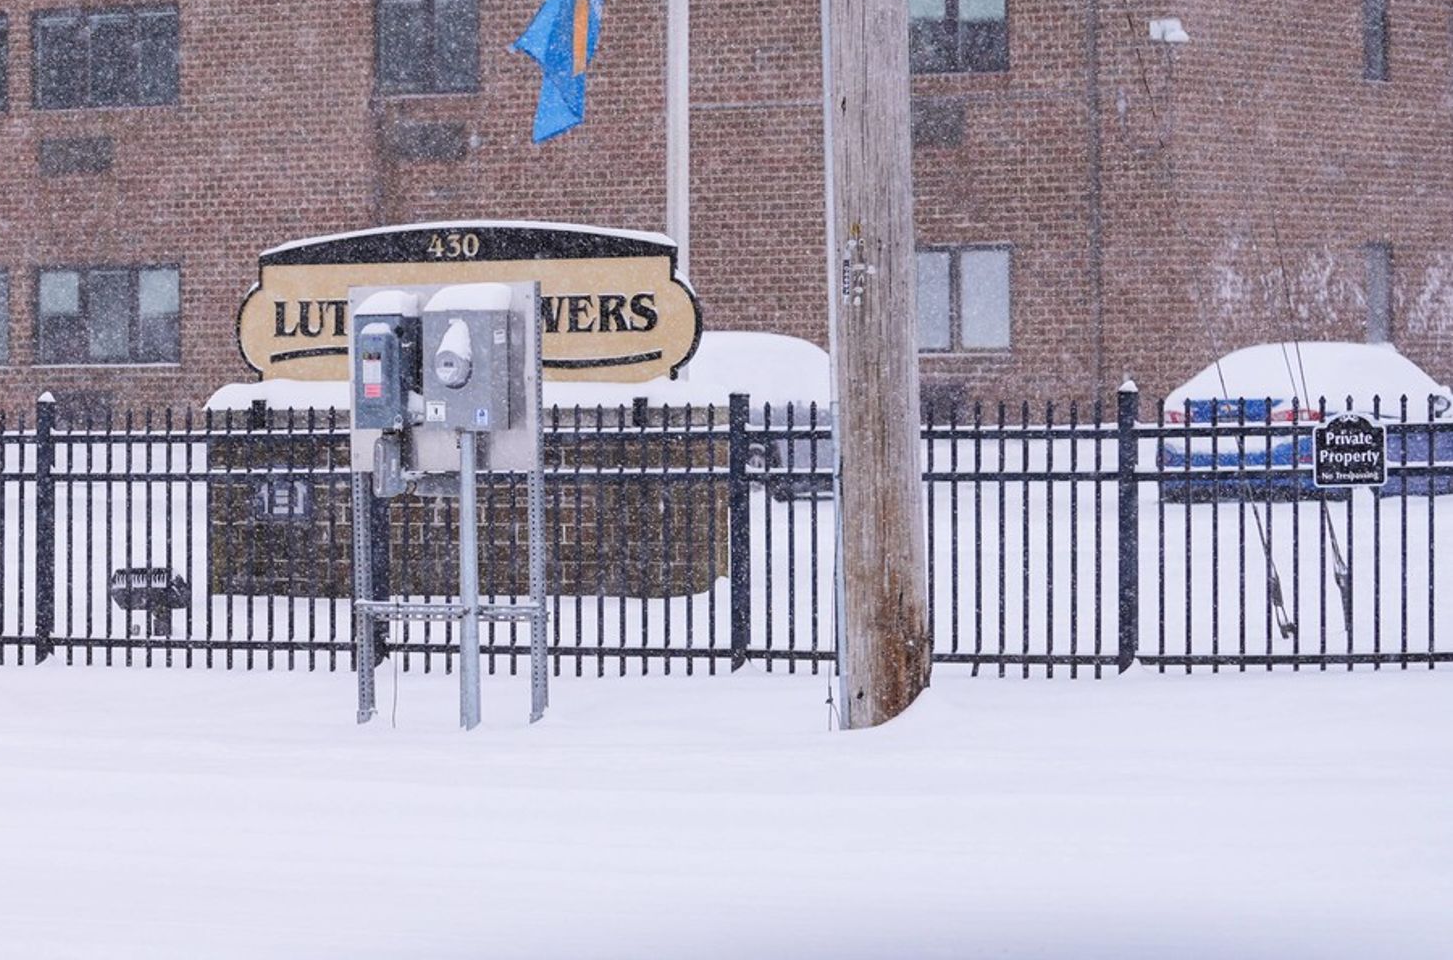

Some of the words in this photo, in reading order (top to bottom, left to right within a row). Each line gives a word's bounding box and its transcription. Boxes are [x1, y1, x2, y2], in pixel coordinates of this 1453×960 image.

[426, 233, 481, 257] 430
[274, 300, 348, 337] LUT
[541, 293, 658, 333] WERS
[1325, 430, 1373, 445] Private
[1320, 450, 1380, 466] Property
